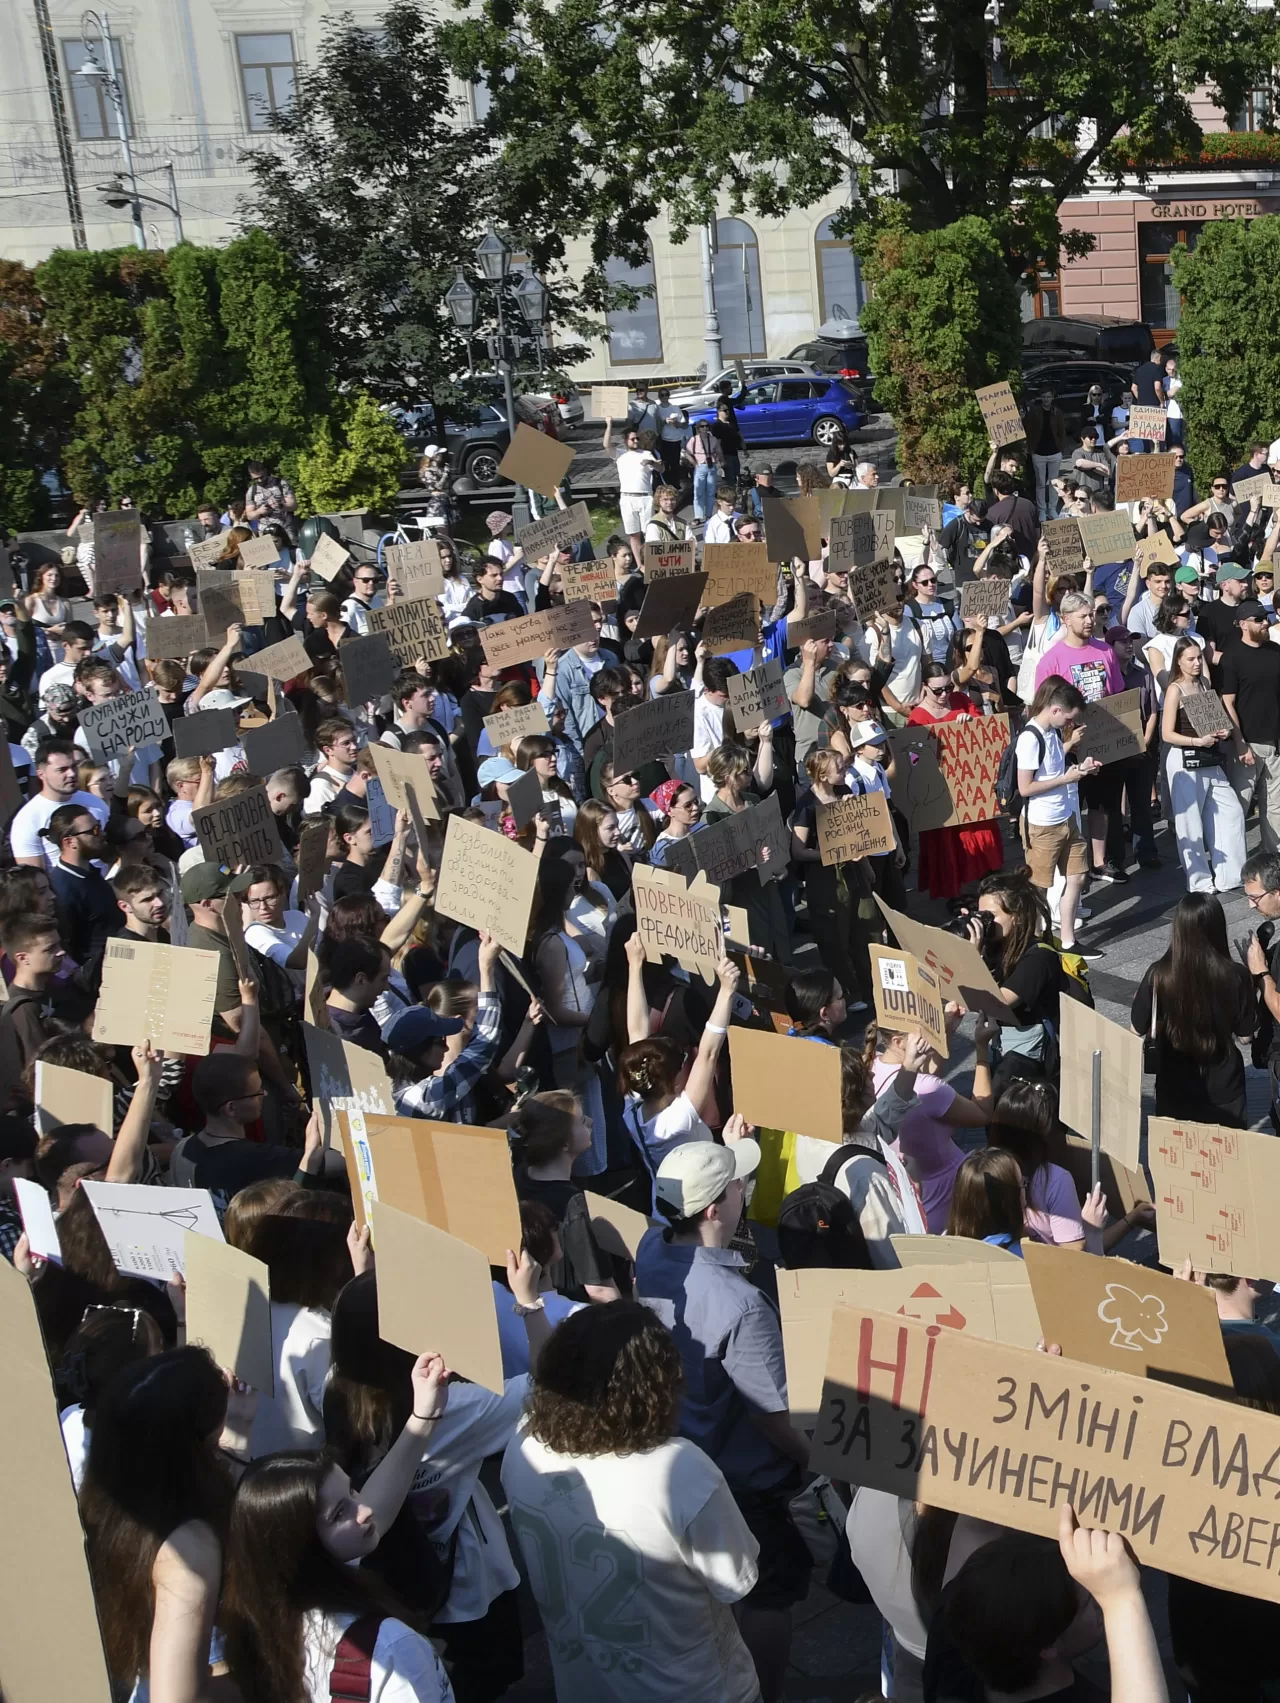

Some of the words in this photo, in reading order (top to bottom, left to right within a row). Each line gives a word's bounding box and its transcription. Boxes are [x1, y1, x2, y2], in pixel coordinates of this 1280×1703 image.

[1152, 203, 1208, 218] GRAND
[1213, 202, 1261, 217] HOTEL
[1133, 420, 1164, 430] ВЛАДИ
[1121, 457, 1173, 476] СЬОГОДНІ
[1142, 470, 1168, 480] МЕНТ
[831, 512, 895, 538] ПОВЕРНІТЬ
[192, 540, 221, 557] БЕЗ
[524, 531, 569, 557] ПОВЕРНІТЬ
[557, 529, 589, 549] ЕДОРОВА
[832, 535, 891, 561] ФЕДОРОВА
[390, 545, 425, 563] ІДЕЯ
[657, 556, 682, 568] ЧУТИ
[565, 584, 591, 597] СТАРІ
[594, 578, 617, 591] ДІДИ
[850, 569, 870, 584] ТАКЕ
[969, 593, 1007, 606] МІНІСТР
[370, 612, 387, 631] НЕ
[388, 598, 434, 625] ЧІПАЙТЕ
[399, 623, 421, 643] ХТО
[422, 616, 442, 639] ДАЄ
[484, 628, 506, 642] Таке
[706, 630, 745, 648] ВОРОГУ
[392, 637, 444, 669] ЗУЛЬТАТ
[741, 666, 769, 692] МИ
[83, 702, 115, 728] СЛУГА
[97, 705, 151, 738] СЛУЖИ
[101, 718, 165, 758] НАРОДУ
[200, 792, 271, 846] ФЕДОРОВА
[826, 794, 869, 818] УКРАЇНУ
[827, 807, 881, 830] ВБИВАЮТЬ
[824, 822, 865, 841] РОСІЯНИ
[856, 828, 872, 842] ТА
[453, 821, 516, 869] Дозволити
[825, 843, 850, 861] ТУПІ
[850, 834, 887, 857] РІШЕННЯ
[455, 846, 516, 887] звільнити
[439, 892, 477, 921] Сили
[451, 880, 503, 916] зрадити
[636, 885, 712, 925] ПОВЕРНІТЬ
[639, 914, 722, 961] ФЕДОРОВА!
[823, 1399, 871, 1461] ЗА
[895, 1418, 1165, 1545] ЗАЧИНЕНИМИ
